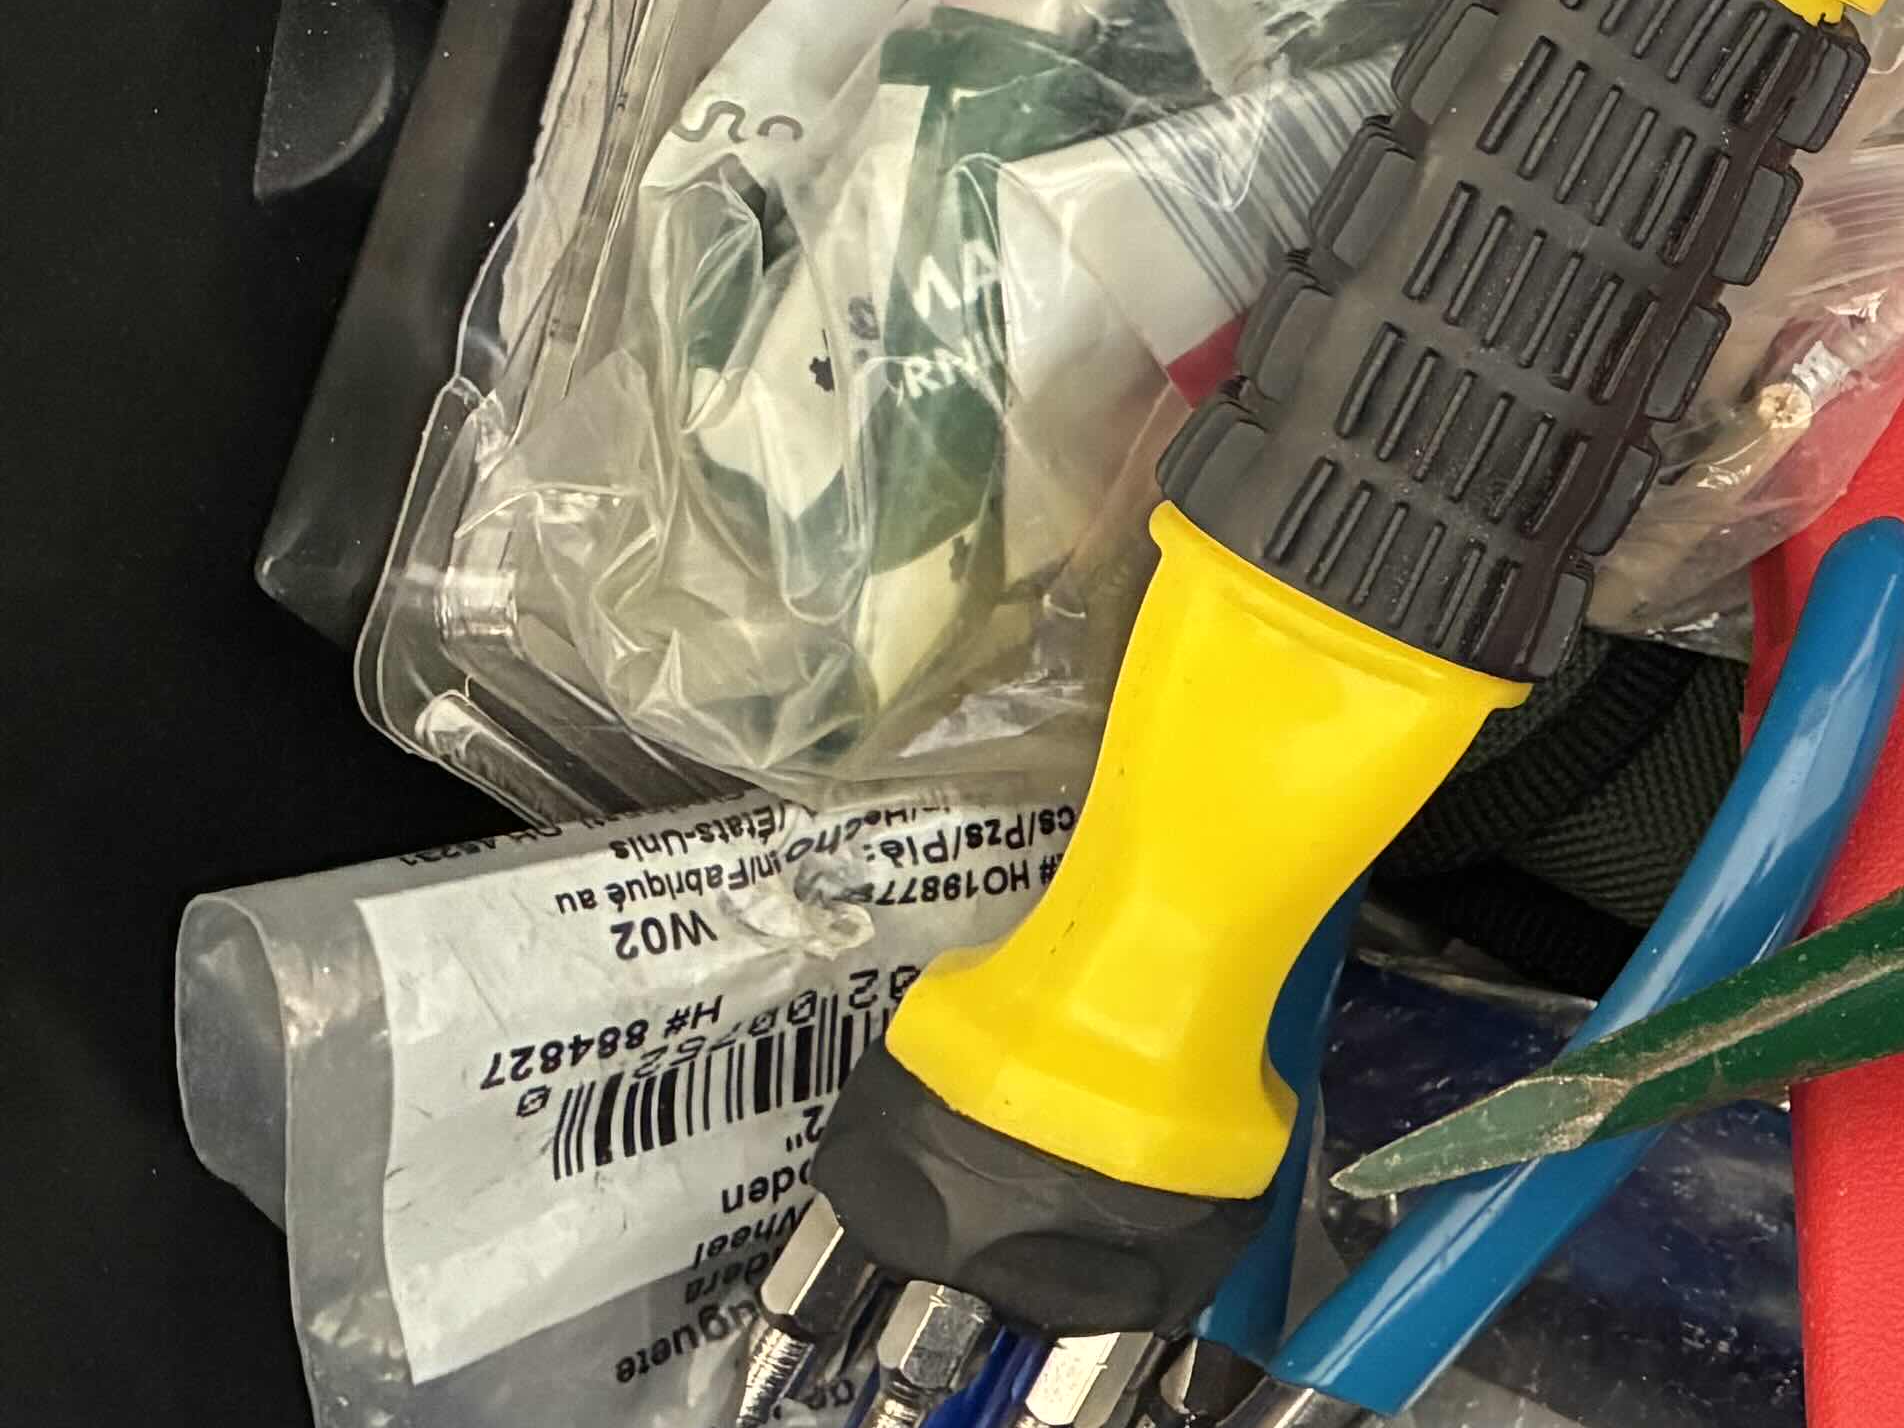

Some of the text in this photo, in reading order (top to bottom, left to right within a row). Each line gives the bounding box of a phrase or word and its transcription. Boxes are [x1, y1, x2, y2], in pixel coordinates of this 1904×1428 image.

[609, 800, 786, 862] /États-Unis
[865, 805, 1077, 868] cs/Pzs/Piè:
[554, 889, 599, 916] au
[609, 909, 719, 962] W02
[479, 1018, 651, 1091] 884827
